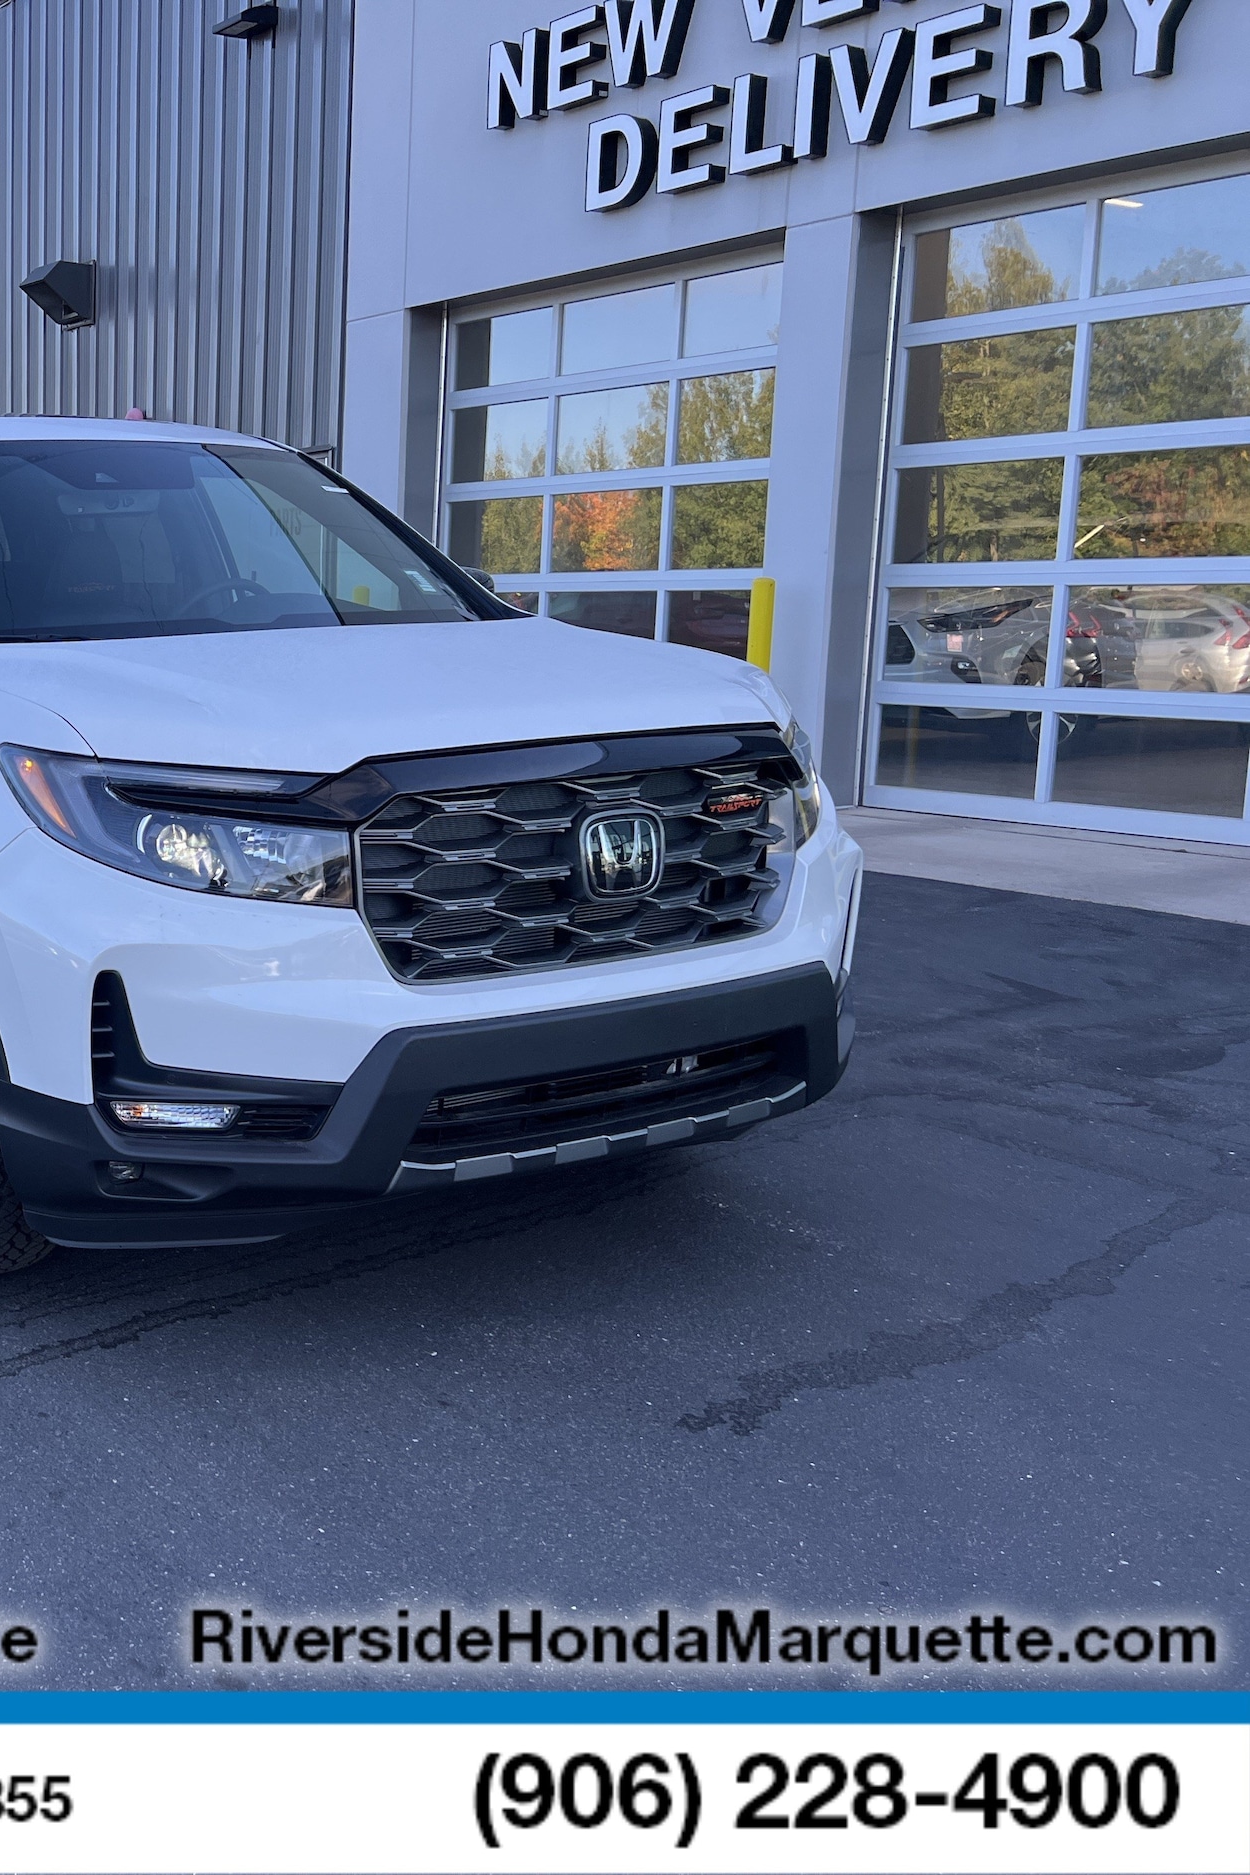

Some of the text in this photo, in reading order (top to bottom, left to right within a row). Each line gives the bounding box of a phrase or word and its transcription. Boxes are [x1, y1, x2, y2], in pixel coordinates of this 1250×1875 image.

[486, 0, 695, 130] NEW
[584, 0, 1193, 212] DELIVERY
[710, 798, 762, 813] TRAILSPORT
